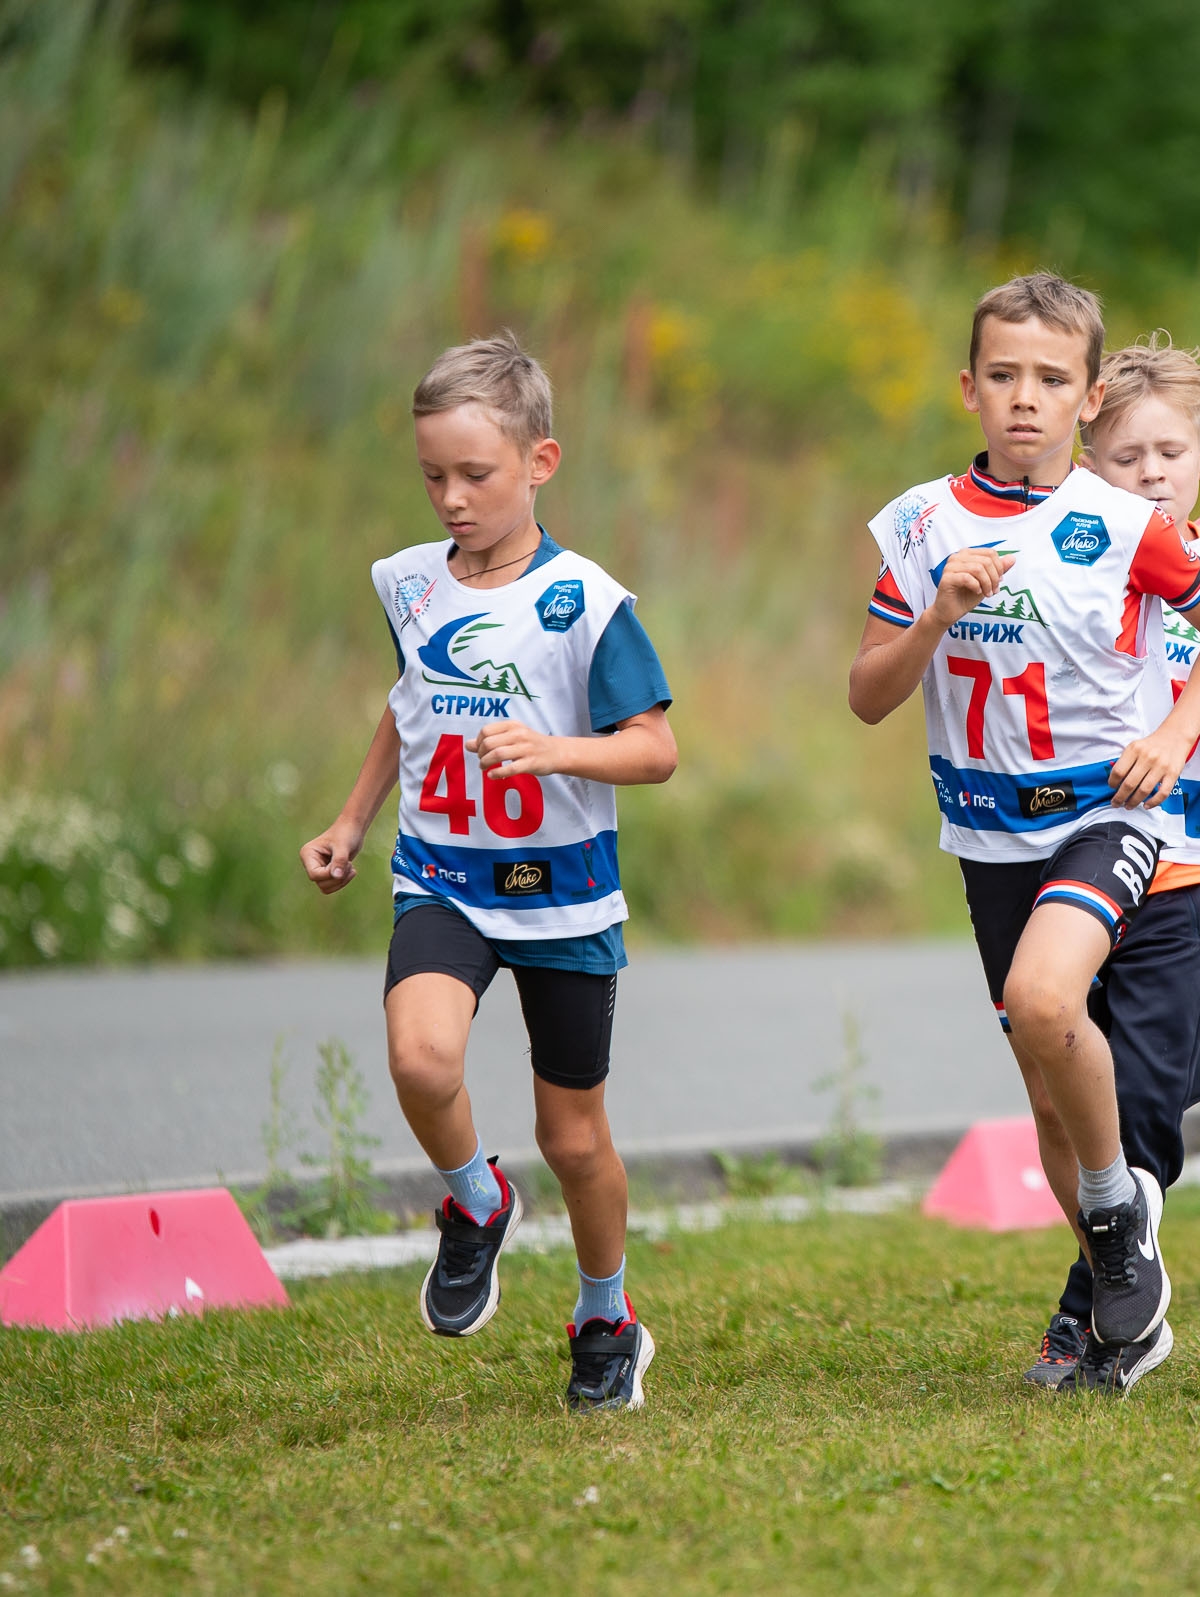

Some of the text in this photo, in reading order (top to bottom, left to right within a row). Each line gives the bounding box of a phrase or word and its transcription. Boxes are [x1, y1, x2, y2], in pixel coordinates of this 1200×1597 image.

[948, 621, 1024, 644] СТРИЖ
[431, 694, 510, 718] СТРИЖ
[946, 655, 1055, 761] 71
[419, 734, 544, 838] 46
[973, 795, 996, 809] ПСБ
[438, 868, 467, 884] ПСБ
[505, 863, 542, 890] Макс
